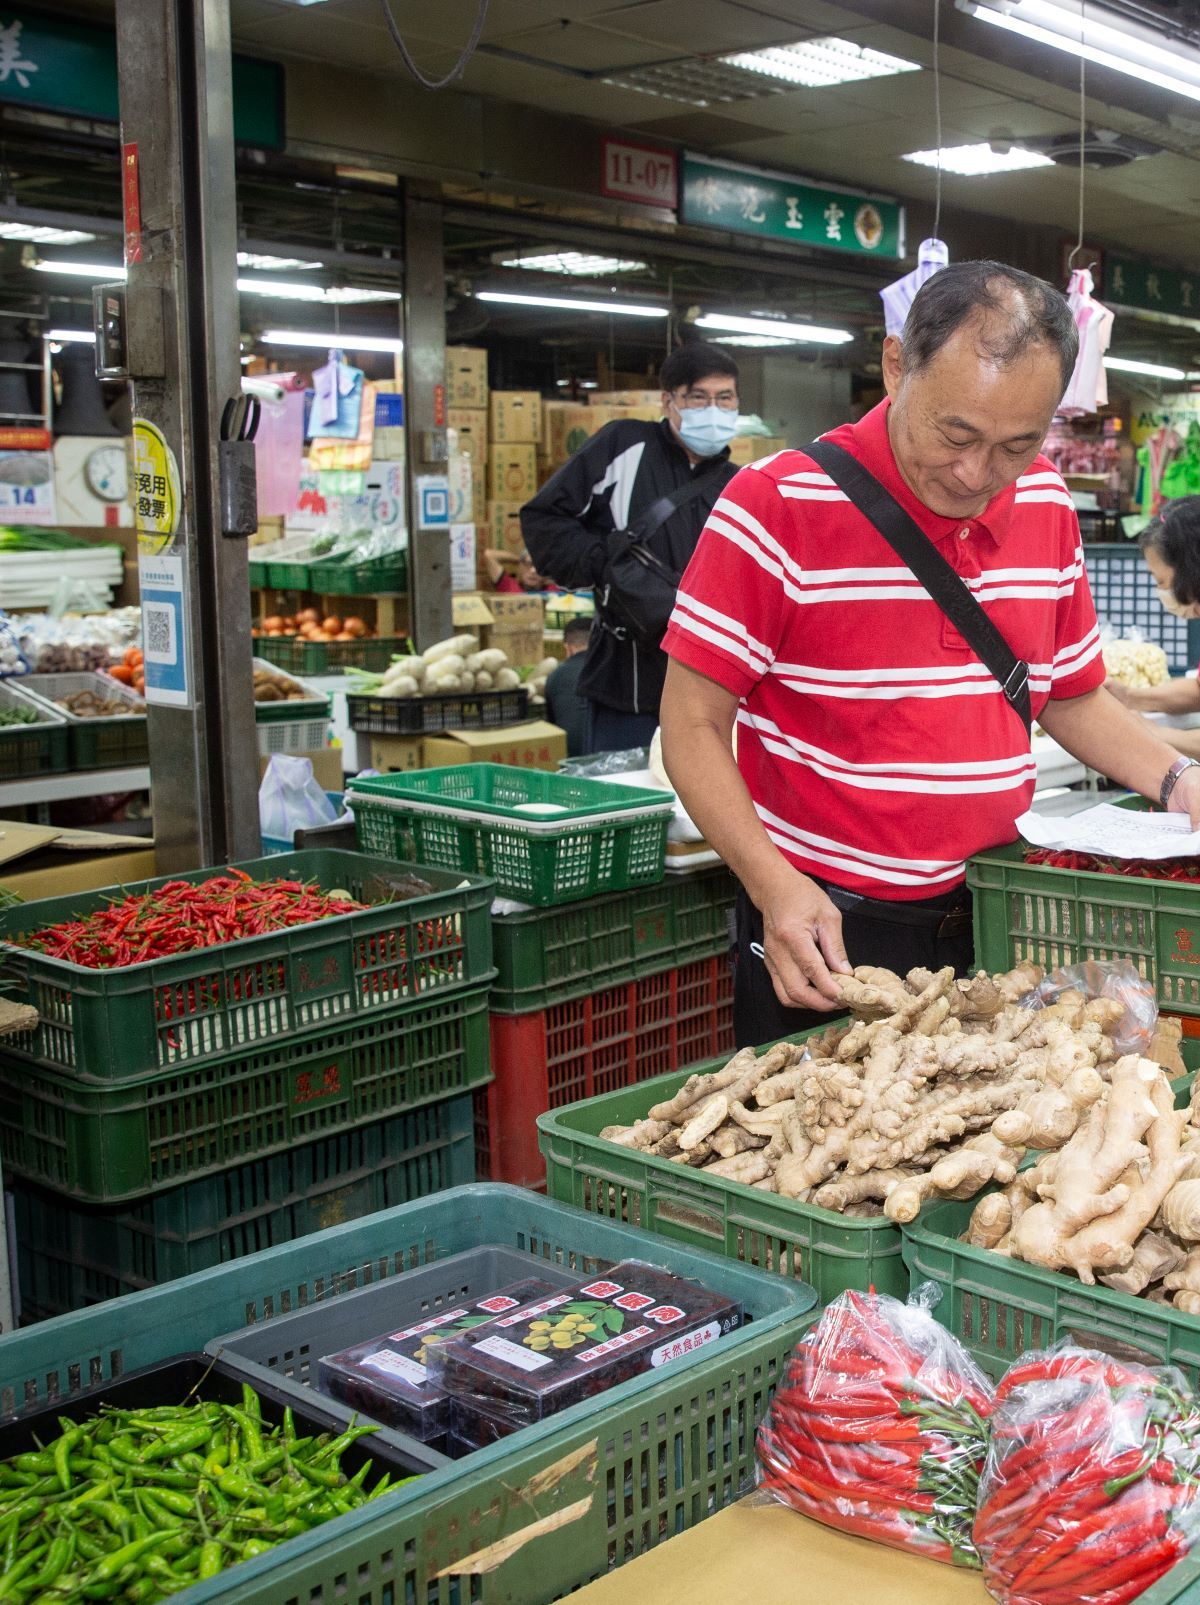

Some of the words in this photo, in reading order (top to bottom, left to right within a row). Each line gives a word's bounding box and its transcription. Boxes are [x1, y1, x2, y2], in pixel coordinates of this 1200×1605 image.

[610, 152, 672, 192] 11-07
[660, 1332, 704, 1364] 天然食品
